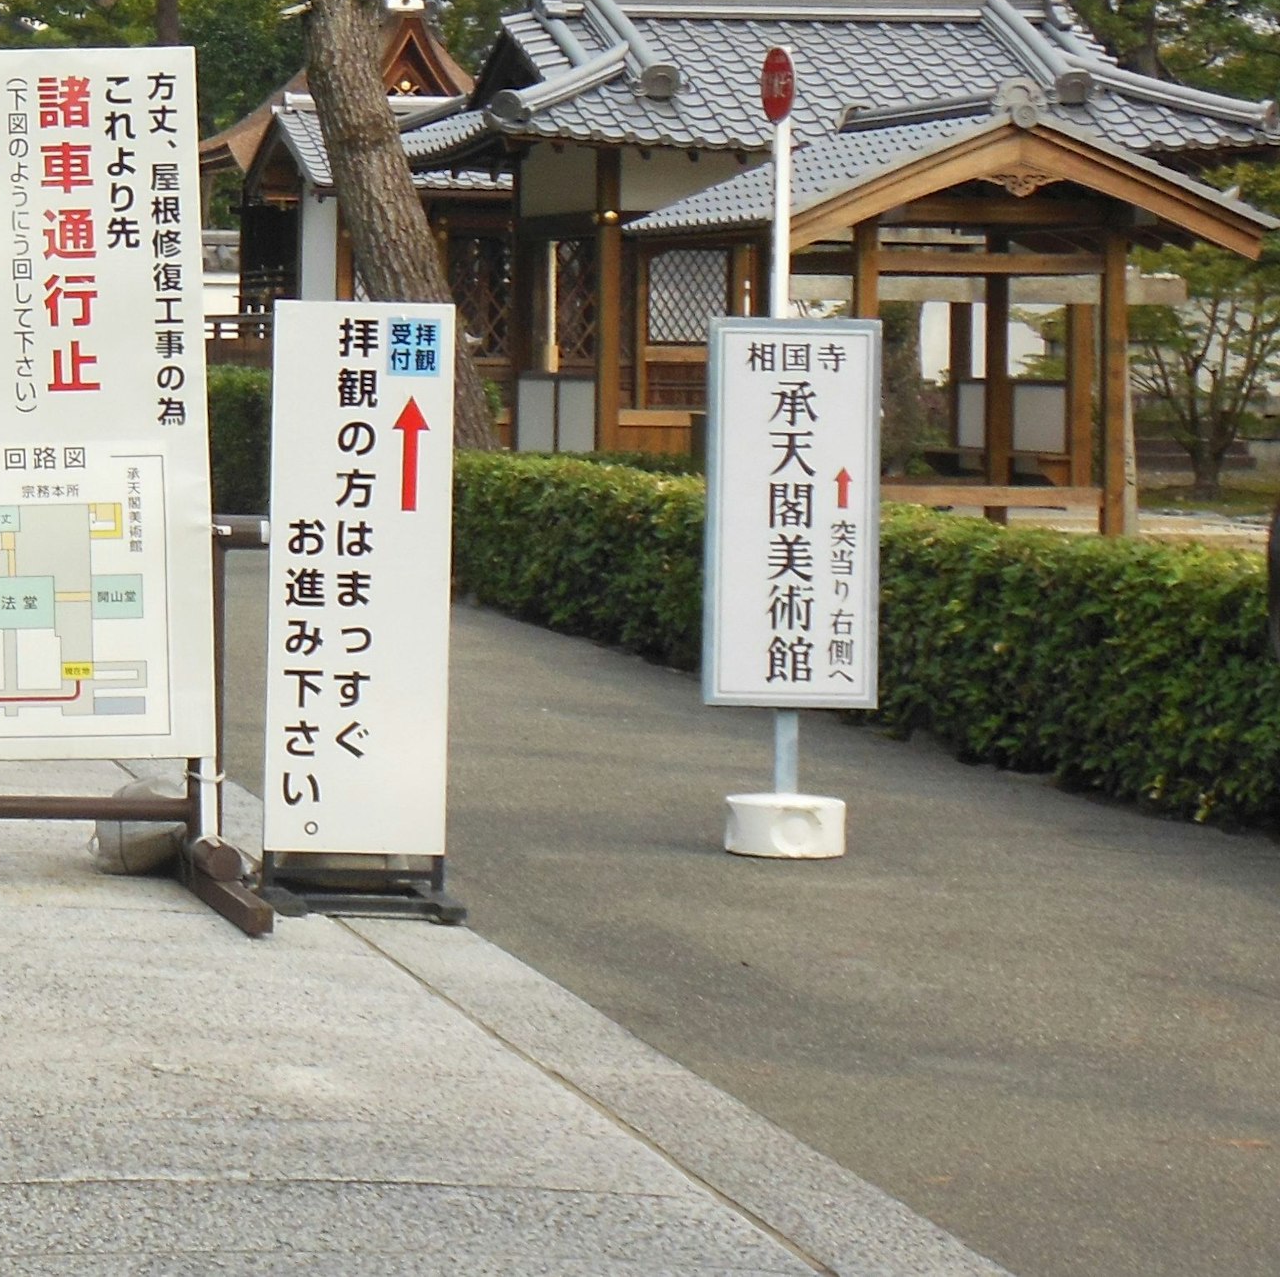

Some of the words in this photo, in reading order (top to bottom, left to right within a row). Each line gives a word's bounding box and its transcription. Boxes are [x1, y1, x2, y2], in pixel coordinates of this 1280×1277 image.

[6, 77, 38, 414] （下図のようにう回して下さい）
[37, 75, 101, 393] 諸車通行止
[103, 76, 140, 249] これより先
[146, 72, 186, 426] 方丈、屋根修復工事の為
[391, 323, 411, 371] 受付
[416, 323, 436, 371] 拝観
[748, 342, 847, 373] 相国寺
[21, 484, 80, 499] 宗務本所
[126, 467, 143, 553] 承天閣美術館
[333, 318, 380, 759] 拝観の方はまっすぐ
[765, 381, 818, 684] 承天閣美術館
[1, 595, 39, 611] 法堂
[283, 519, 326, 835] お進み下さい。
